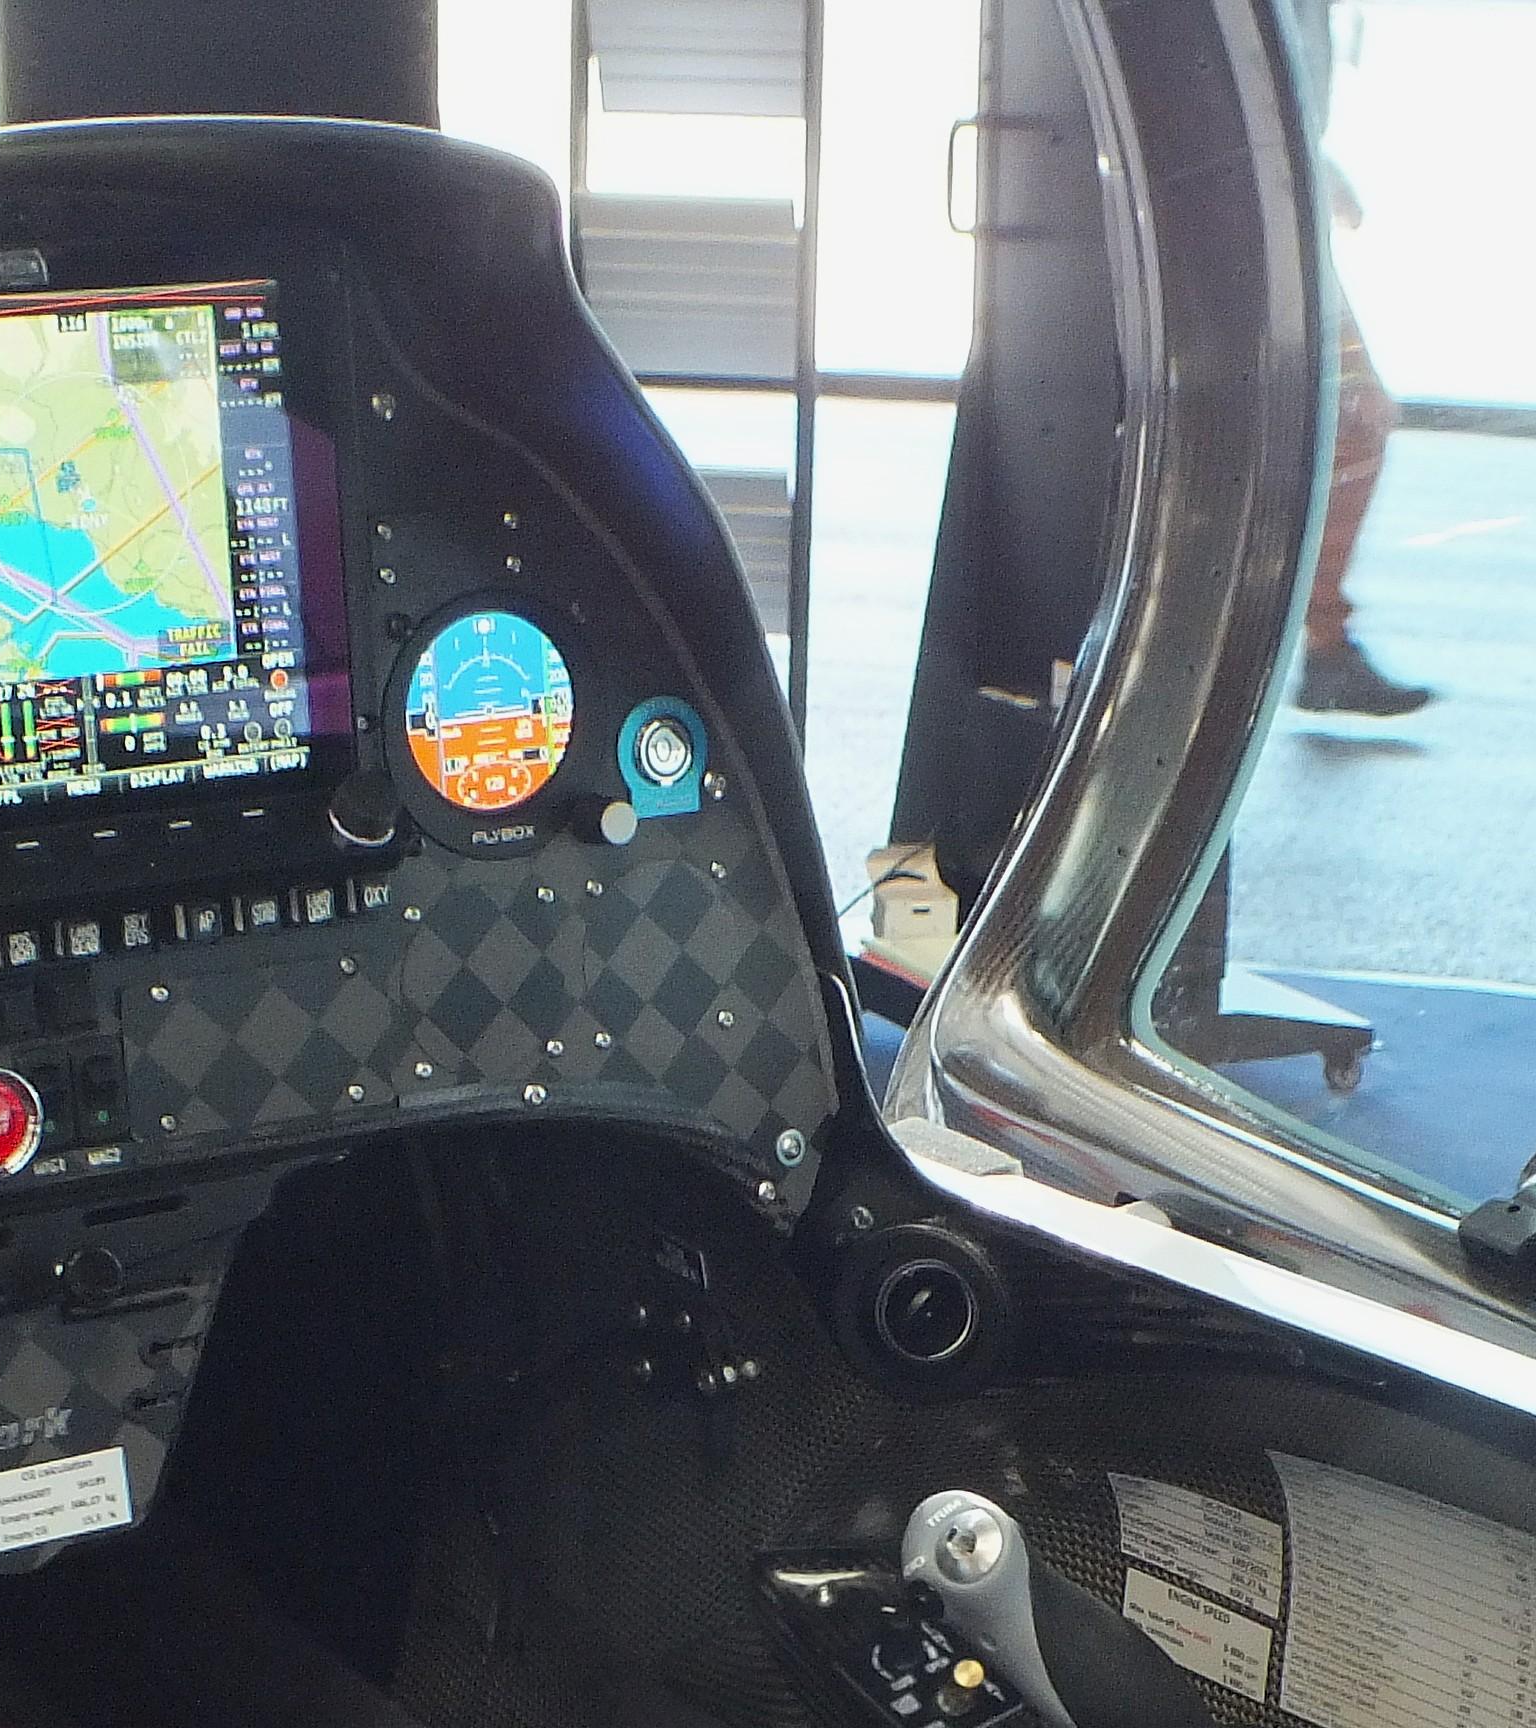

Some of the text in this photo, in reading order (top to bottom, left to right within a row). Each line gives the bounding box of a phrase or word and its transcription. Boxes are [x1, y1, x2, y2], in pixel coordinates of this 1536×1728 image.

[130, 767, 187, 789] DISPLAY
[471, 825, 537, 845] FLYBOX
[364, 884, 390, 908] OXY
[198, 909, 215, 933] AP
[925, 1497, 964, 1529] TRIM
[1167, 1586, 1232, 1626] ENGINE SPEED
